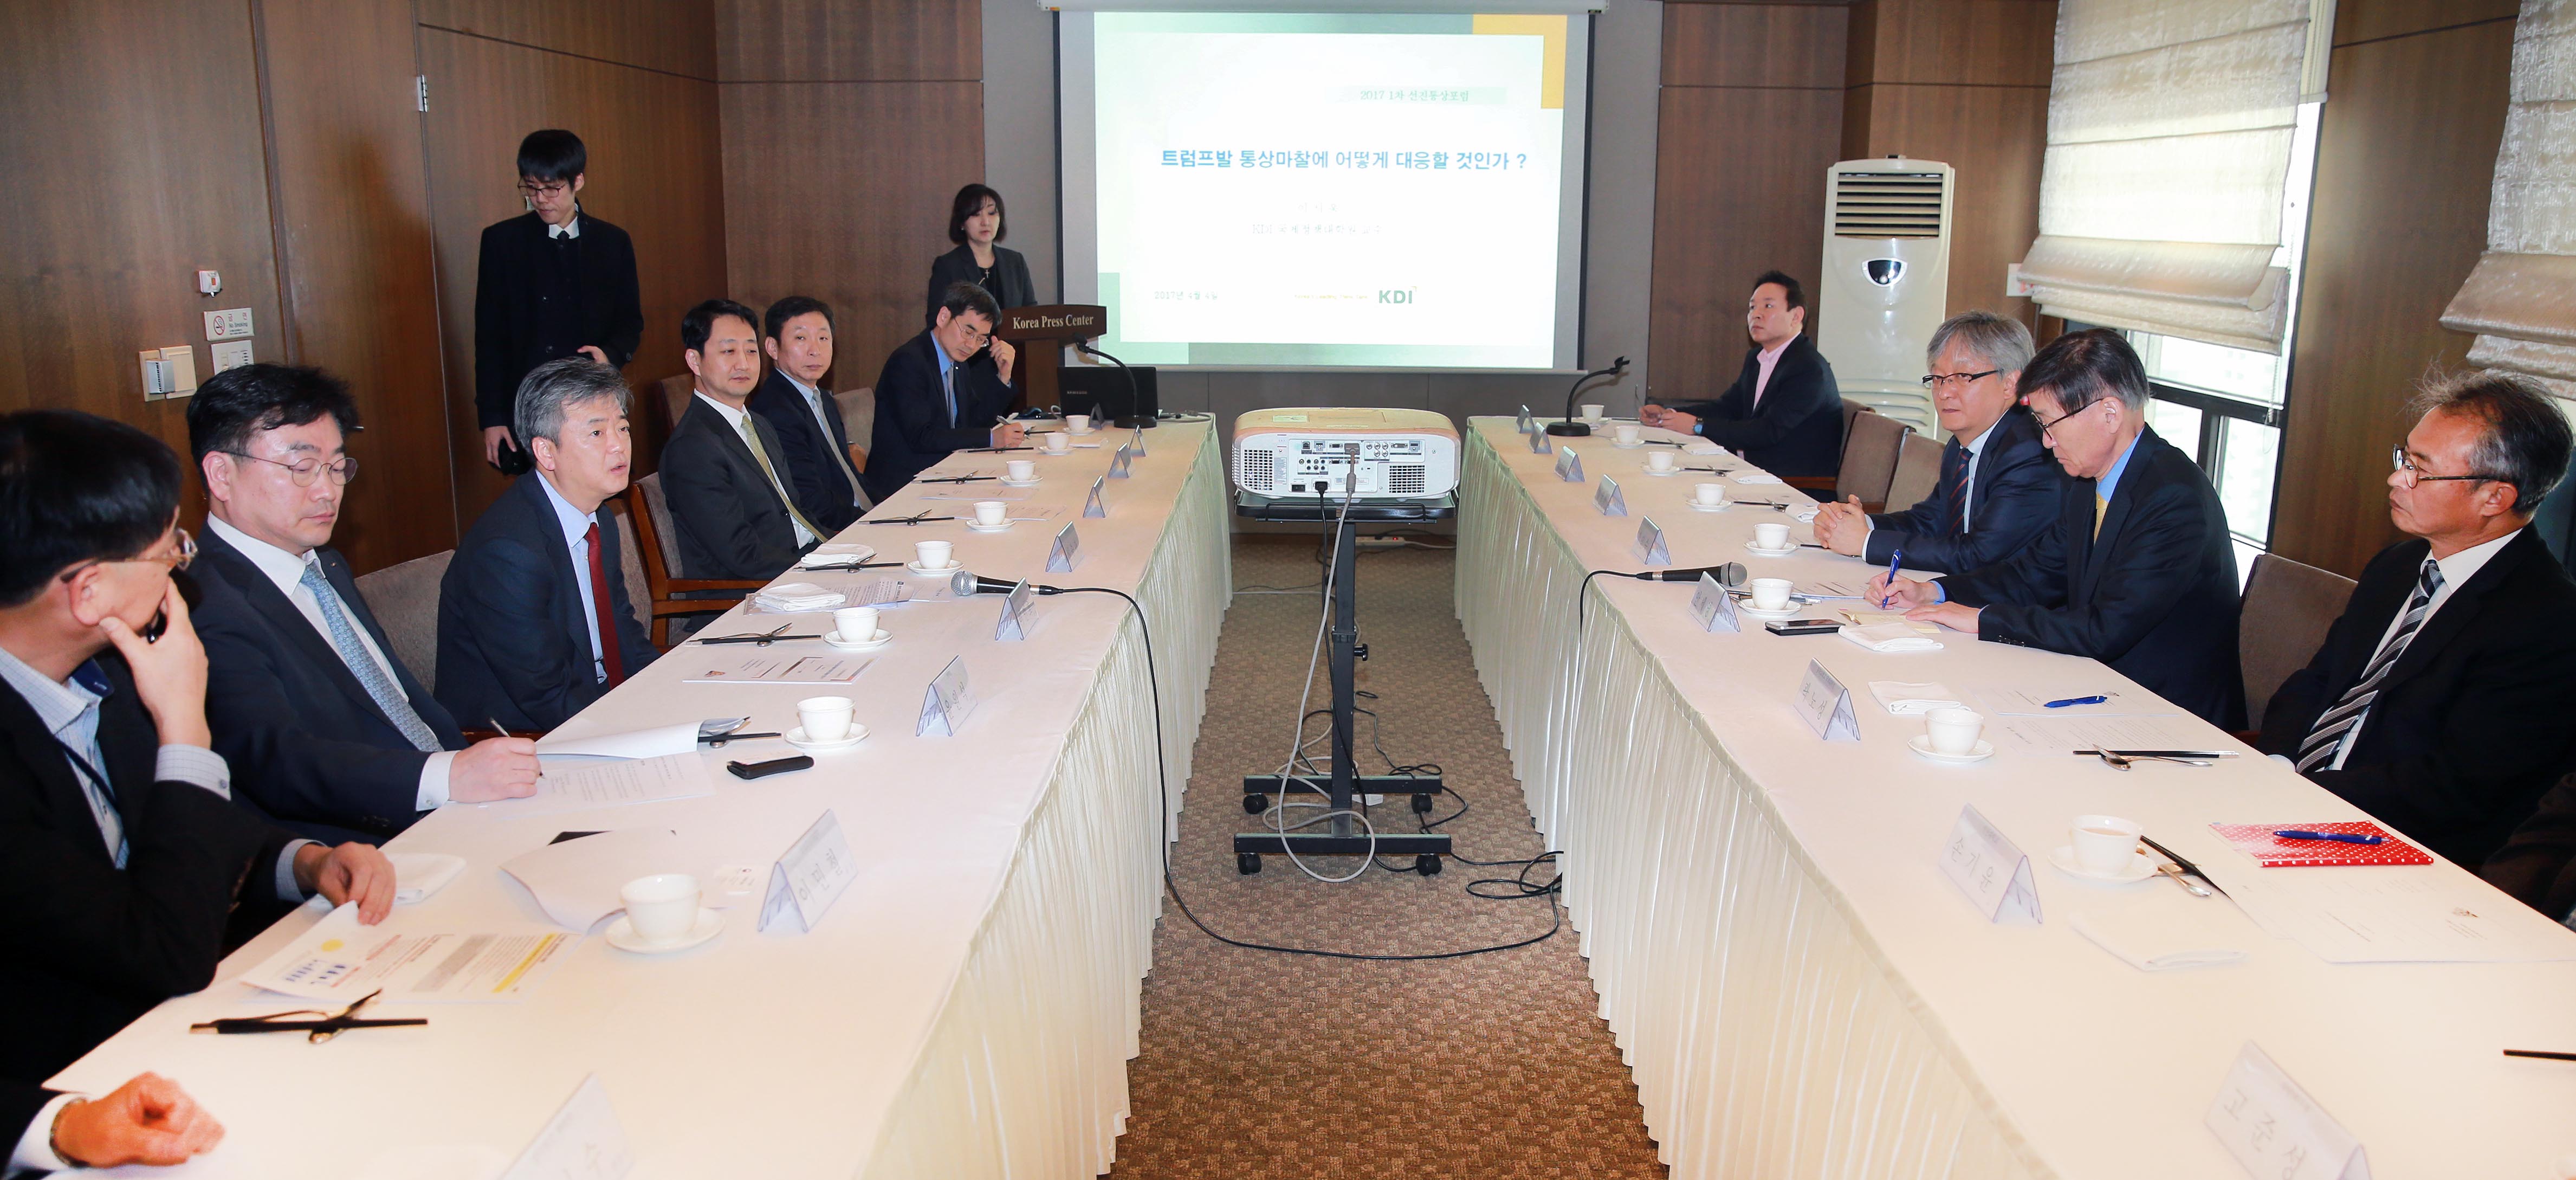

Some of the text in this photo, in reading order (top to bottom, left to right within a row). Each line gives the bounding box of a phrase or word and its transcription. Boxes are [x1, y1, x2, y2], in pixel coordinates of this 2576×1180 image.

[1360, 91, 1384, 100] 2017
[1161, 150, 1233, 167] 트럼프발
[1239, 150, 1328, 168] 통상마찰에
[1336, 151, 1389, 169] 어떻게
[1396, 151, 1449, 170] 대응할
[1456, 152, 1510, 170] 것인가
[1378, 290, 1413, 304] KDI
[1013, 314, 1094, 330] Korea Press Center
